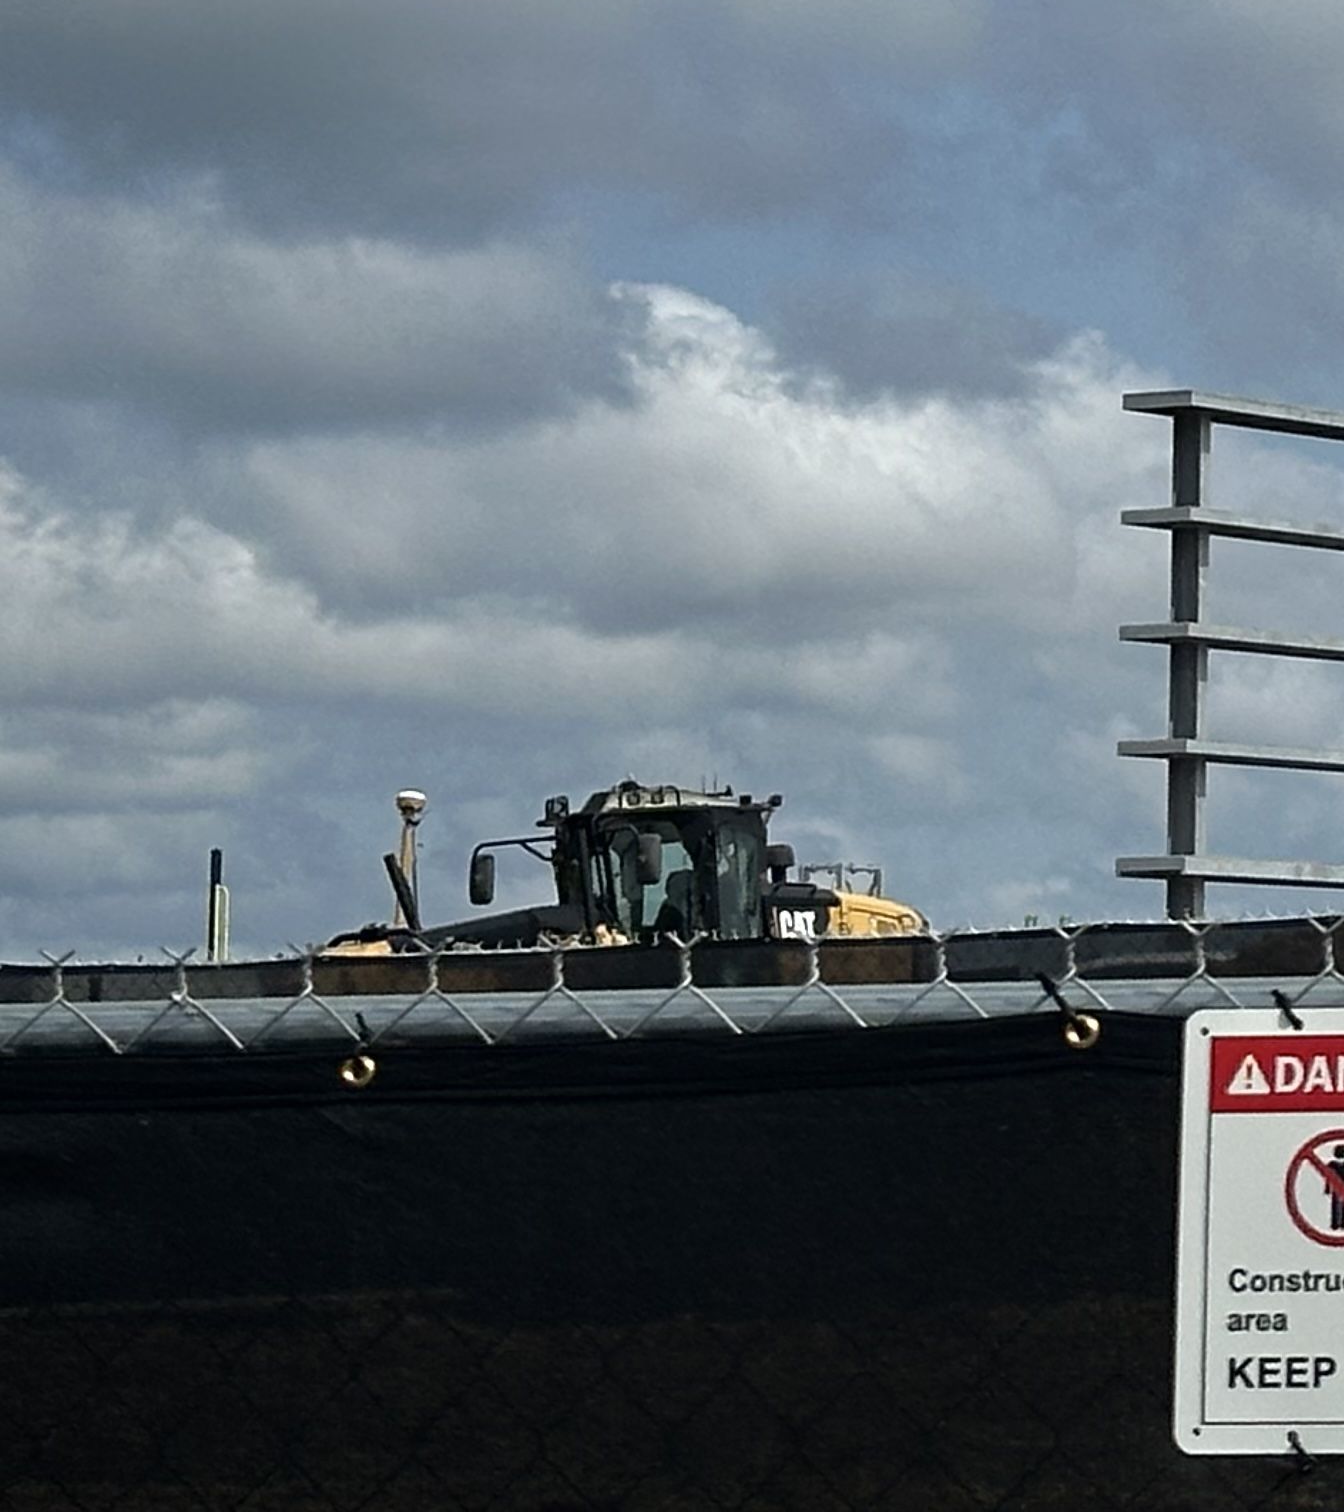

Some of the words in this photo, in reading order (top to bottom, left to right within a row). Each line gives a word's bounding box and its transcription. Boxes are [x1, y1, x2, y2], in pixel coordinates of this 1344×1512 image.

[779, 910, 816, 939] CAT
[1226, 1311, 1289, 1332] area
[1227, 1356, 1337, 1389] KEEP
